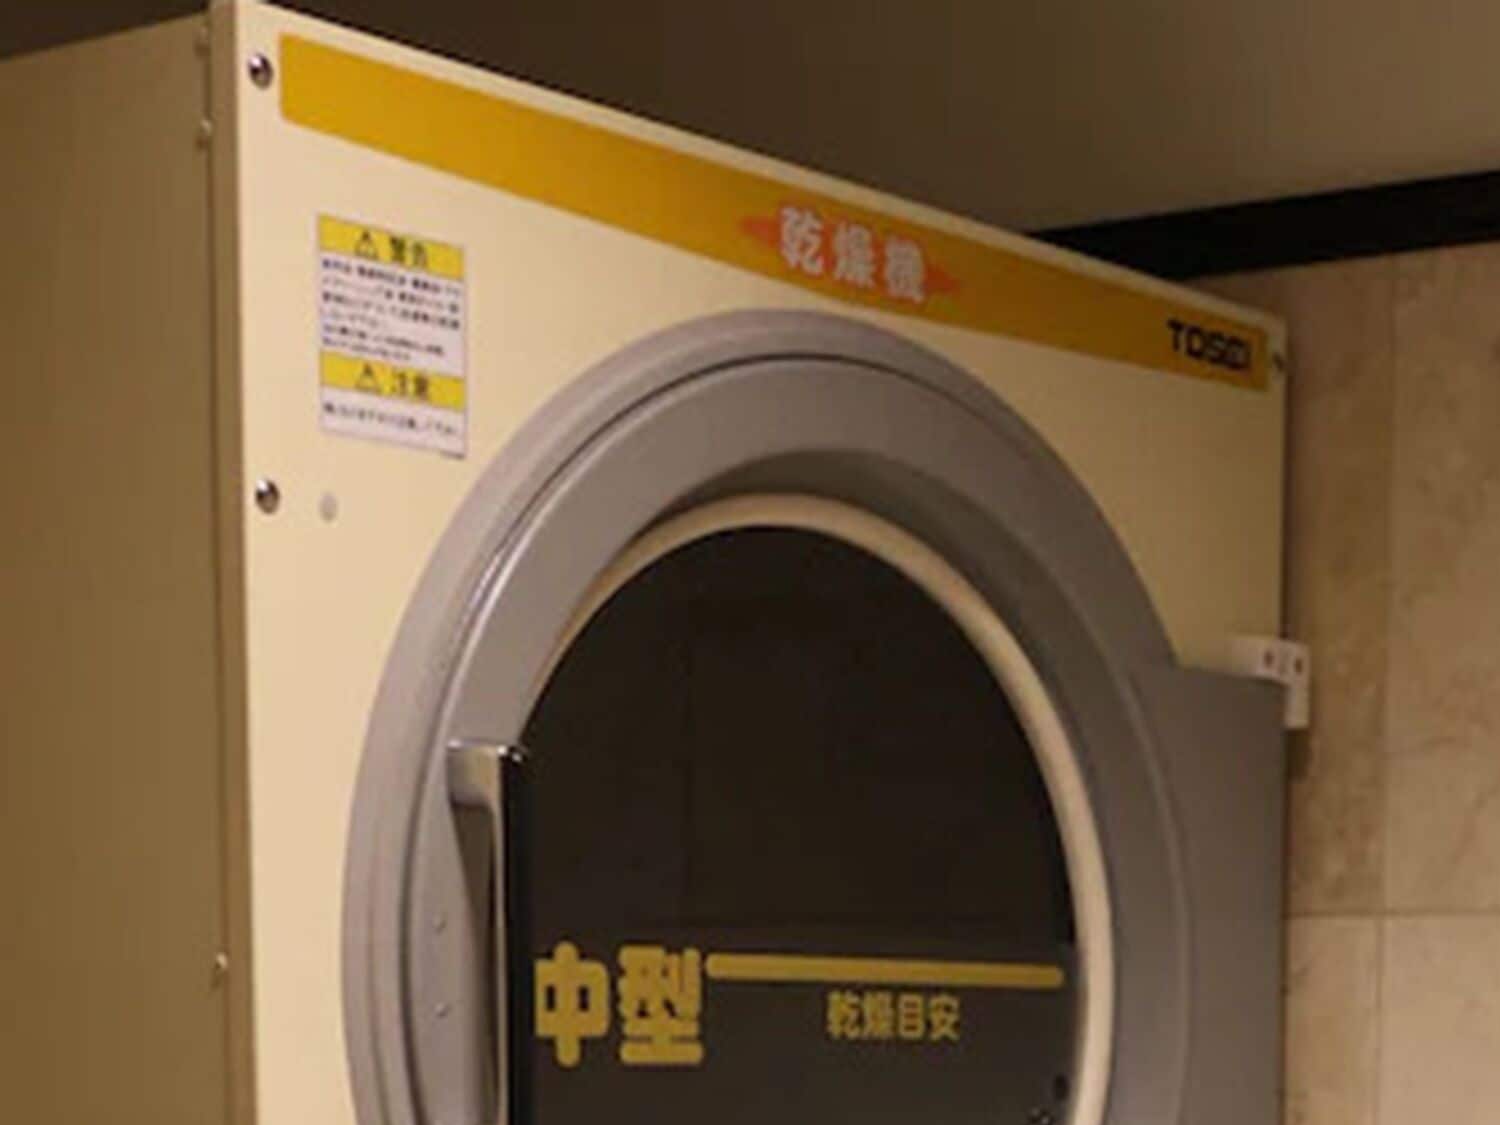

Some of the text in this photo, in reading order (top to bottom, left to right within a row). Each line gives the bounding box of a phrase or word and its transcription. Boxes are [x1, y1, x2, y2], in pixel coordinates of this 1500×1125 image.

[780, 206, 926, 303] 乾燥機
[534, 941, 704, 1068] 中型
[826, 990, 961, 1041] 乾燥目安
